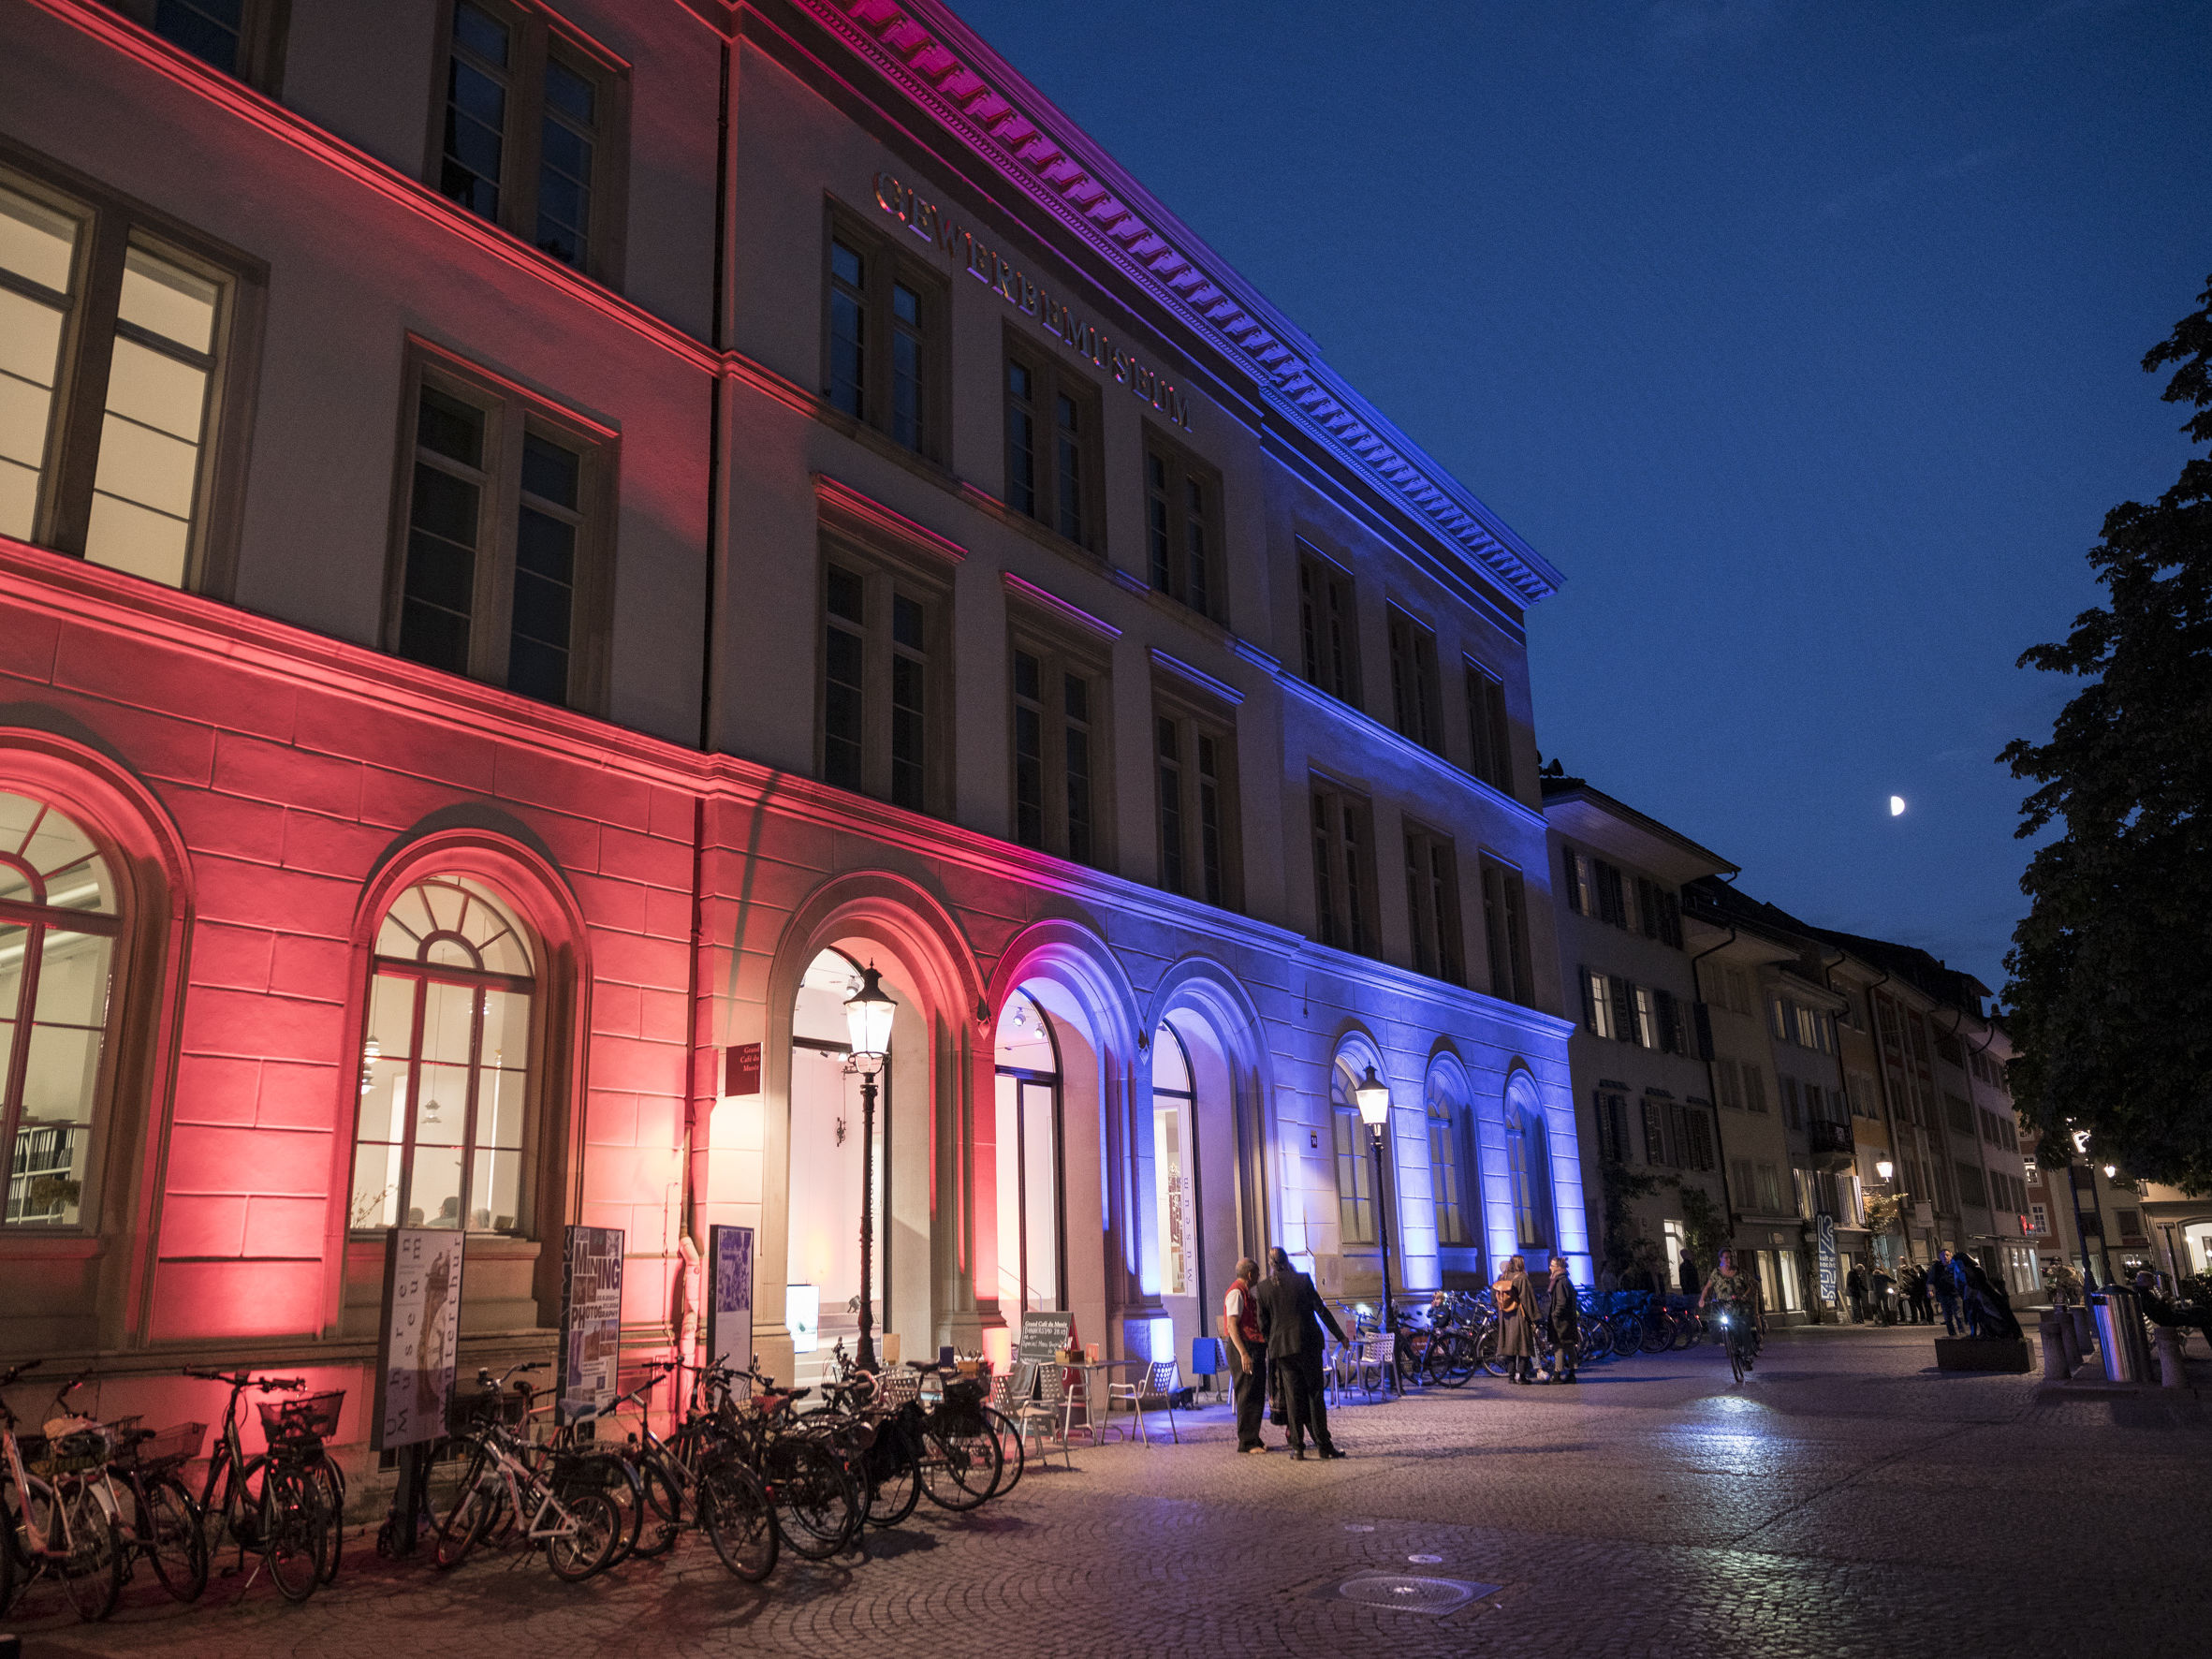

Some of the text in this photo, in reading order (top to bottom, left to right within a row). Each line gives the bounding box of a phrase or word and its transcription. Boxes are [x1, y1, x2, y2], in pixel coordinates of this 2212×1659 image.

[872, 170, 1194, 434] GEWERBEMUSEUM
[743, 1045, 760, 1053] Grand
[574, 1241, 621, 1290] MINING
[1183, 1177, 1194, 1283] Museum
[385, 1237, 411, 1436] Uhren
[396, 1237, 422, 1433] Museum
[570, 1305, 619, 1329] PHOTOGRAPHY
